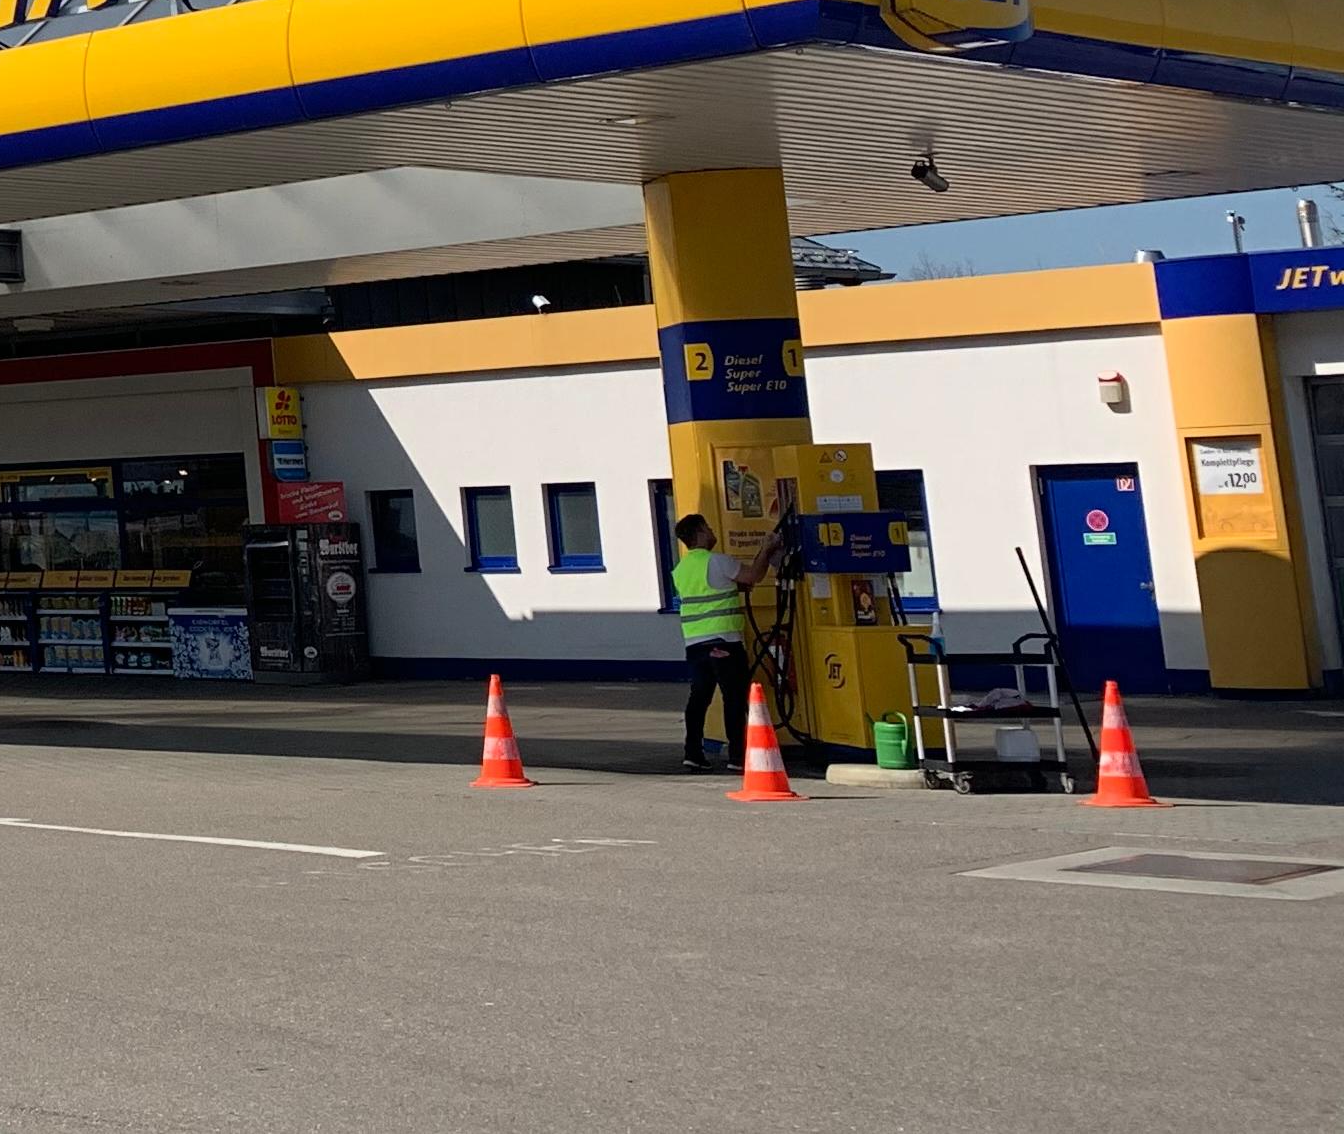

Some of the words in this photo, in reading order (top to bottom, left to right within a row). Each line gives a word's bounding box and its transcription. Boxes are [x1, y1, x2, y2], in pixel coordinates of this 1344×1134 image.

[695, 353, 708, 371] 2
[724, 354, 763, 366] Diesel
[787, 349, 797, 367] 1
[725, 369, 761, 380] Super
[727, 382, 761, 394] Super
[766, 380, 787, 391] E10
[272, 415, 297, 425] LOTTO
[833, 529, 840, 540] 2
